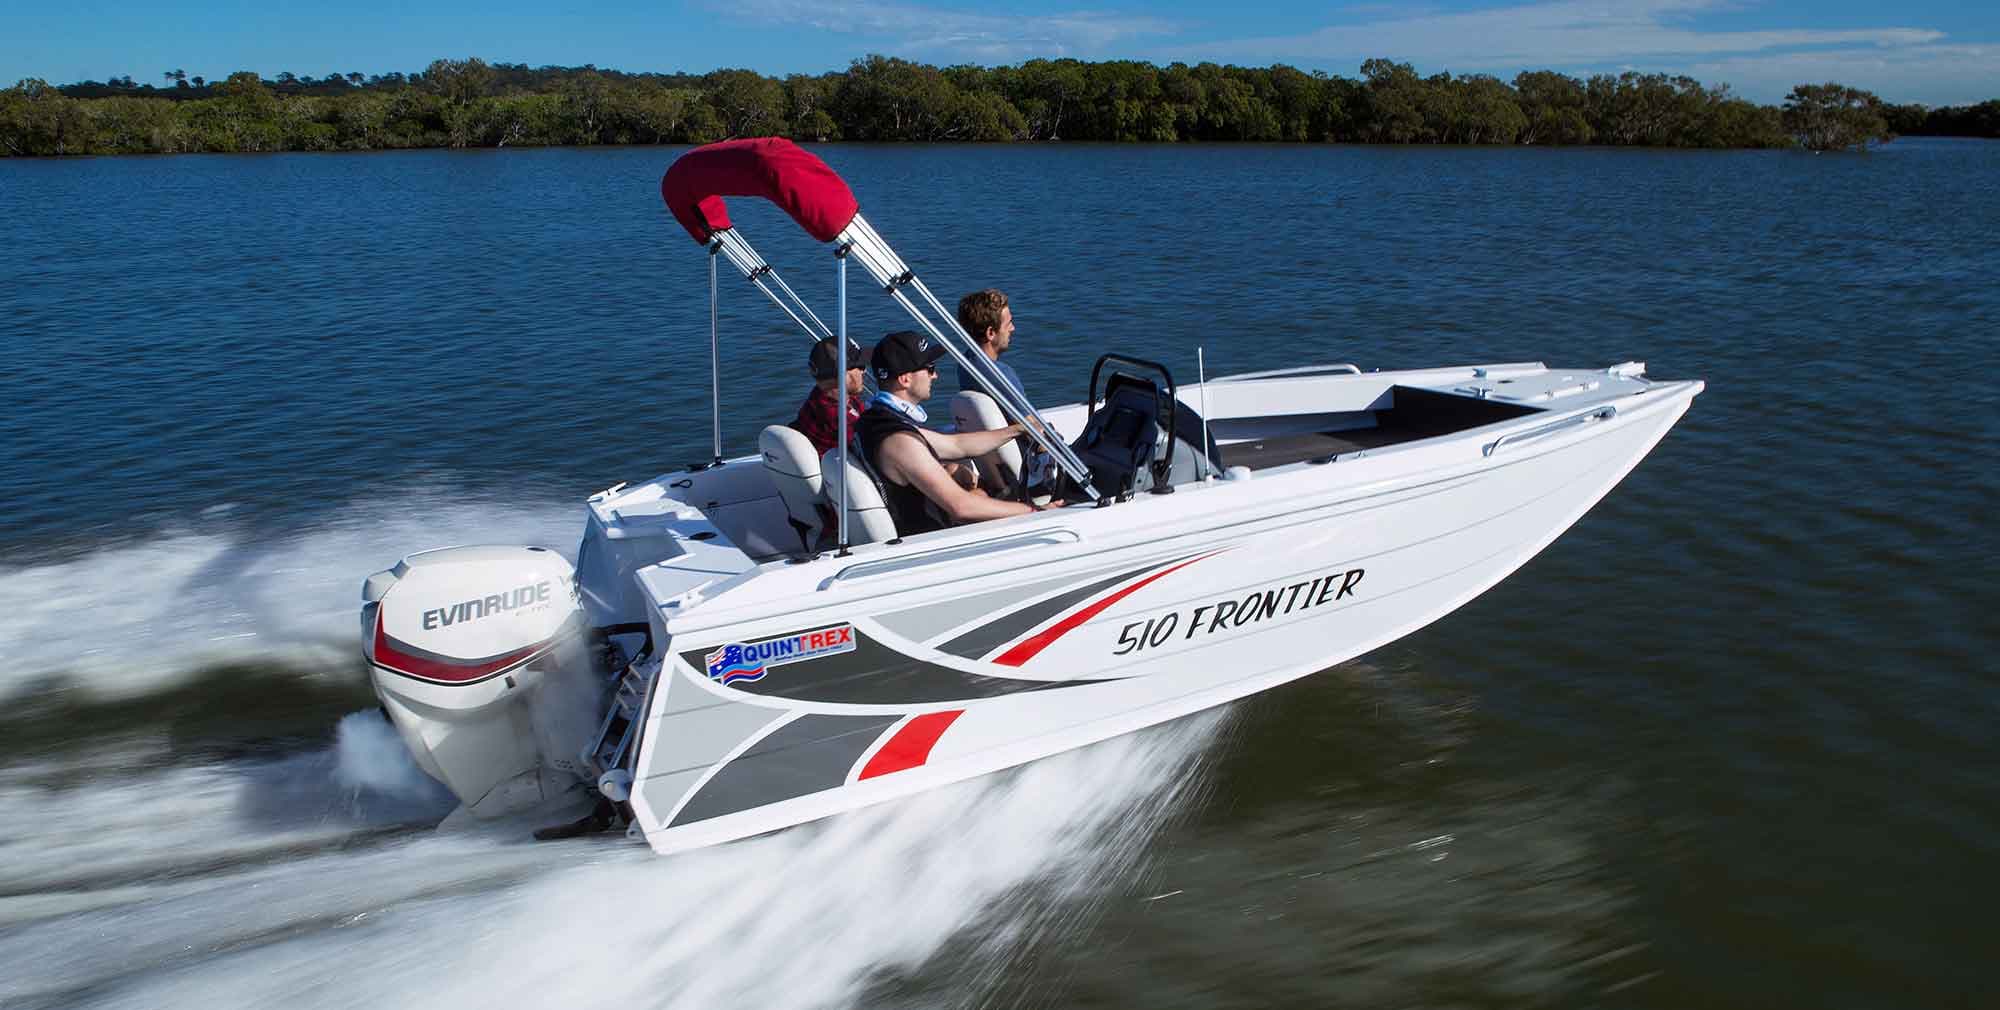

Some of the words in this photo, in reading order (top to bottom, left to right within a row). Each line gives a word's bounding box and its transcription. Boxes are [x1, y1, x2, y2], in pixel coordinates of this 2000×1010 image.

[422, 581, 551, 630] EVINRUDE
[1113, 612, 1179, 655] 510
[1185, 568, 1365, 640] FRONTIER
[743, 626, 852, 663] QUINTREX
